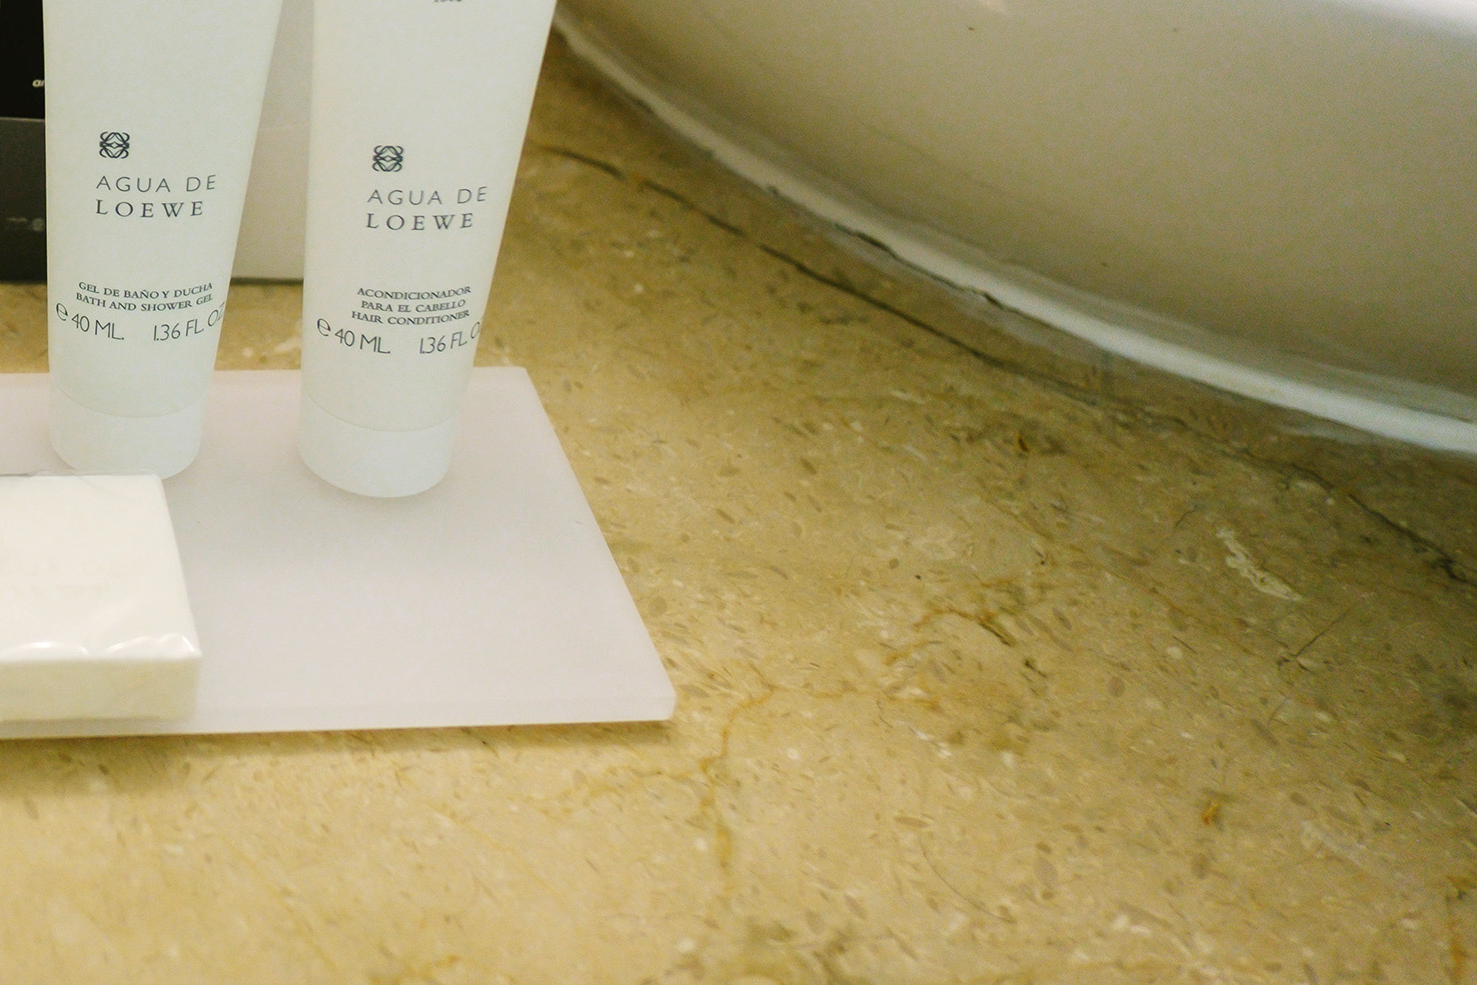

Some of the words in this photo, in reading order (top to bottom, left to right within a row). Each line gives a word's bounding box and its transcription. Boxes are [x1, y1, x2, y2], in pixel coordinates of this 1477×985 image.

[96, 175, 171, 193] AGUA
[185, 174, 216, 192] DE
[367, 189, 442, 206] AGUA
[456, 186, 487, 204] DE
[96, 199, 203, 218] LOEWE
[366, 212, 474, 231] LOEWE
[78, 281, 100, 294] GEL
[103, 287, 120, 297] DE
[124, 289, 159, 299] BAÑO
[162, 290, 170, 299] Y
[174, 282, 213, 298] DUCHA
[357, 286, 471, 300] ACONDICIONADOR
[76, 292, 106, 308] BATH
[109, 301, 137, 311] AND
[140, 300, 192, 312] SHOWER
[196, 293, 214, 306] GEL
[361, 300, 393, 312] PARA
[398, 304, 411, 313] EL
[415, 299, 466, 313] CABELLO
[351, 311, 383, 324] HAIR
[387, 309, 470, 325] CONDITIONER
[71, 313, 90, 333] 40
[153, 322, 181, 342] 1.36
[335, 328, 355, 347] 40
